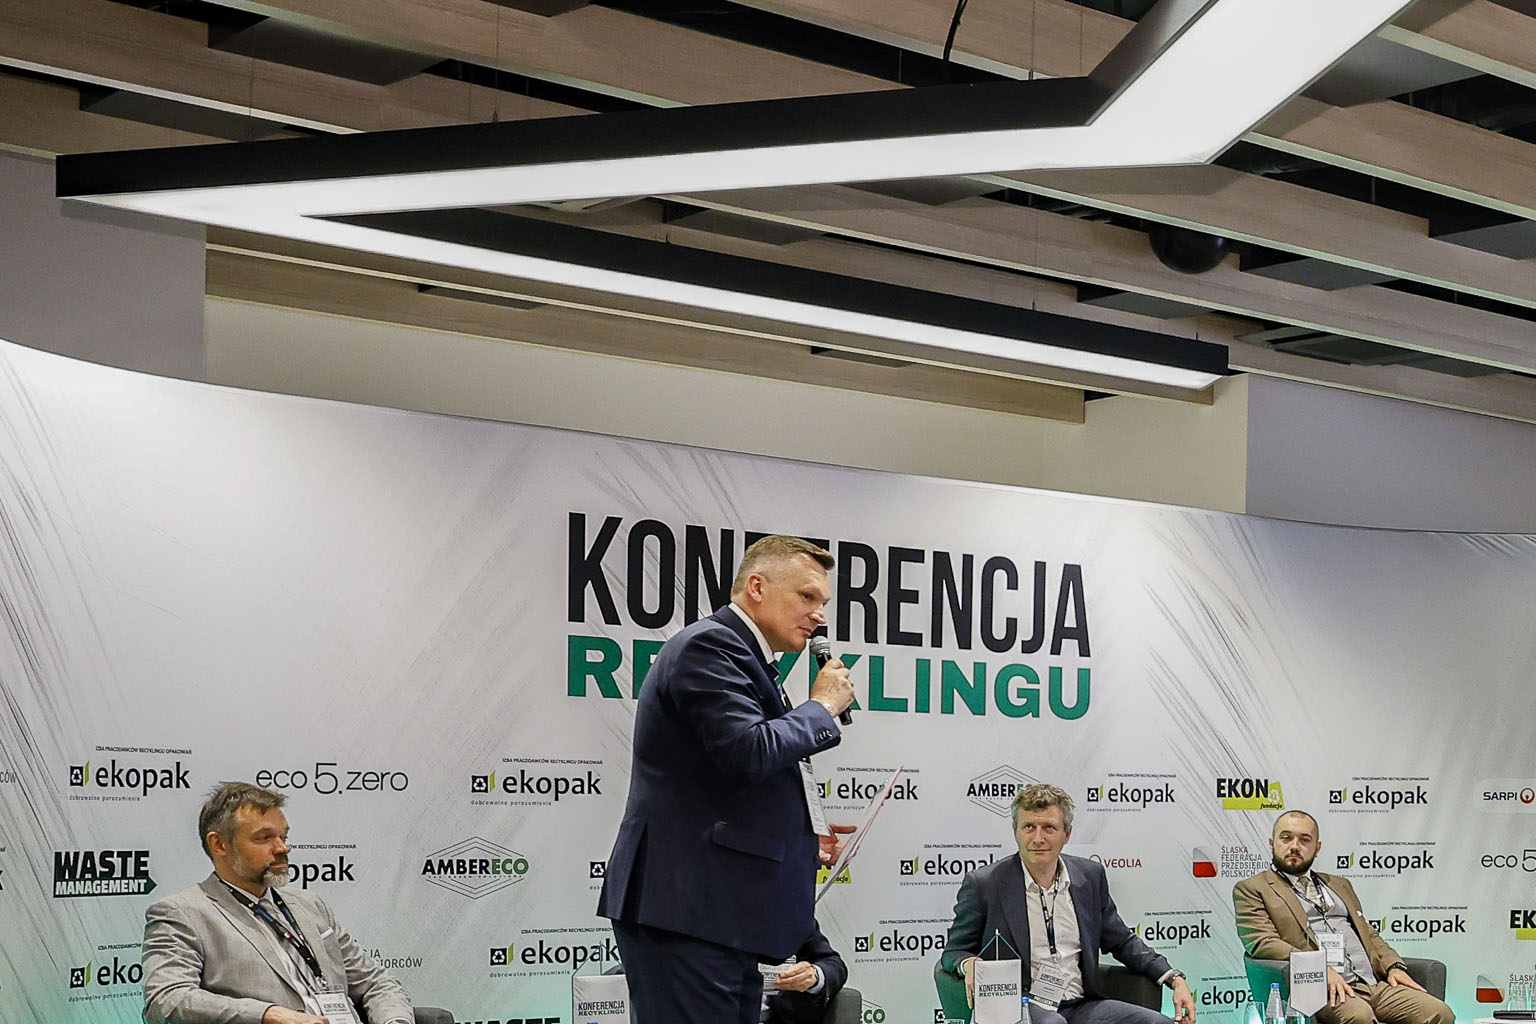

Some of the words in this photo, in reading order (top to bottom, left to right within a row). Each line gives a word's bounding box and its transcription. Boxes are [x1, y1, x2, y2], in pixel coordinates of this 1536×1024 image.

[567, 511, 1091, 658] KONRENCJA
[567, 634, 1091, 720] RELINGU
[95, 760, 190, 796] ekopak
[502, 769, 602, 801] ekopak
[1217, 778, 1269, 798] EKON
[967, 783, 1024, 797] AMBER
[1108, 782, 1175, 808] ekopak
[1352, 785, 1428, 809] ekopak
[1483, 792, 1517, 801] SARPI
[1221, 846, 1248, 856] ŚLĄSKA
[1359, 850, 1434, 874] ekopak
[54, 851, 149, 879] WASTE
[288, 856, 355, 889] opak
[421, 859, 529, 875] AMBERECO
[1103, 858, 1142, 868] VEOLIA
[1221, 862, 1268, 870] PRZEDSIĘBIO
[55, 879, 147, 895] MANAGEMENT
[1144, 919, 1211, 945] ekopak
[1391, 915, 1466, 938] ekopak
[521, 938, 619, 969] ekopak
[879, 928, 950, 956] ekopa
[97, 957, 143, 986] eko
[1509, 973, 1534, 982] ŚLĄSK
[979, 983, 1018, 993] KONFERENCJA
[1201, 986, 1254, 1009] ekop
[578, 1001, 625, 1011] KONFERENCJA
[578, 1009, 625, 1017] RECYKLINGU
